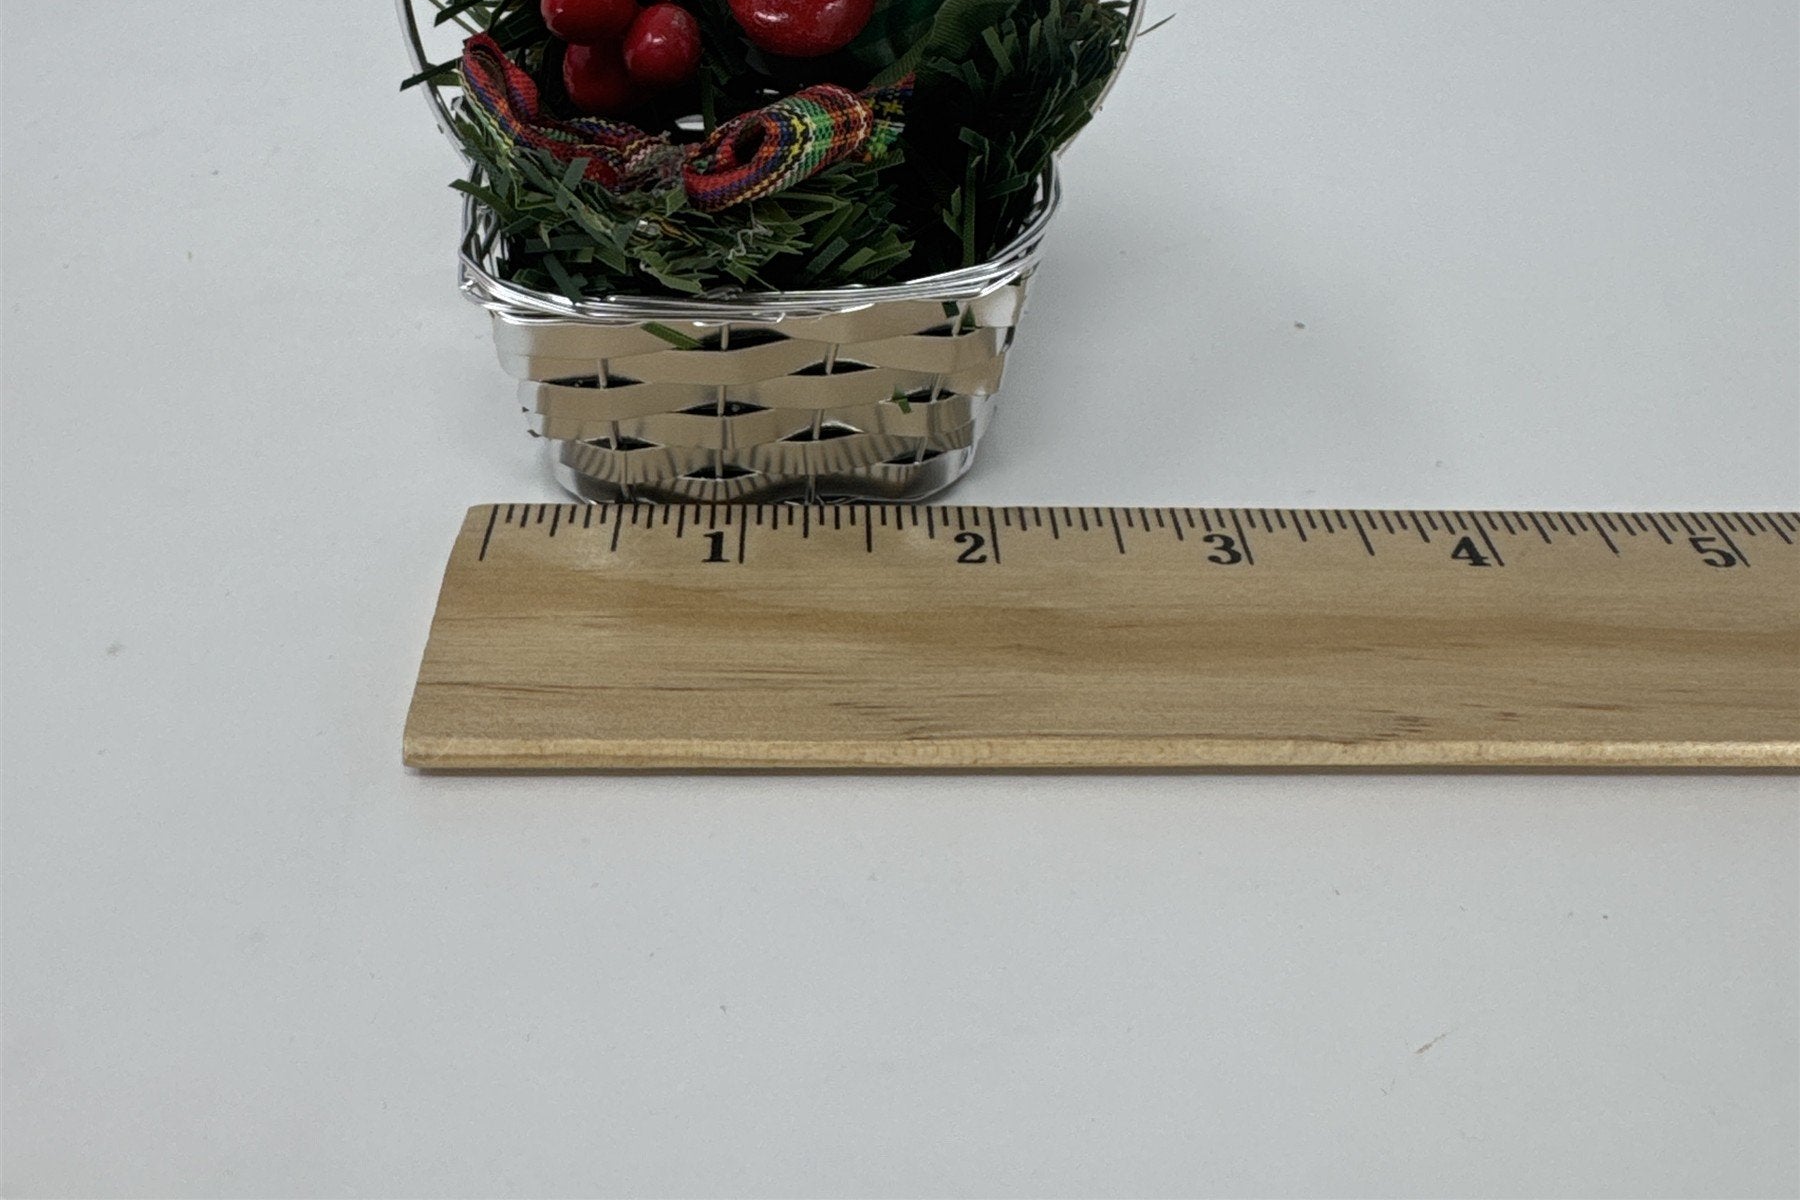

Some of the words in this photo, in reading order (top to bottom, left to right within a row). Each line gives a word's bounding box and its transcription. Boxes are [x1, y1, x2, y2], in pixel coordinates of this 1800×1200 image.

[700, 531, 731, 564] 1
[954, 531, 988, 565] 2
[1203, 533, 1243, 566] 3
[1451, 535, 1492, 568] 4
[1688, 536, 1736, 569] 5
